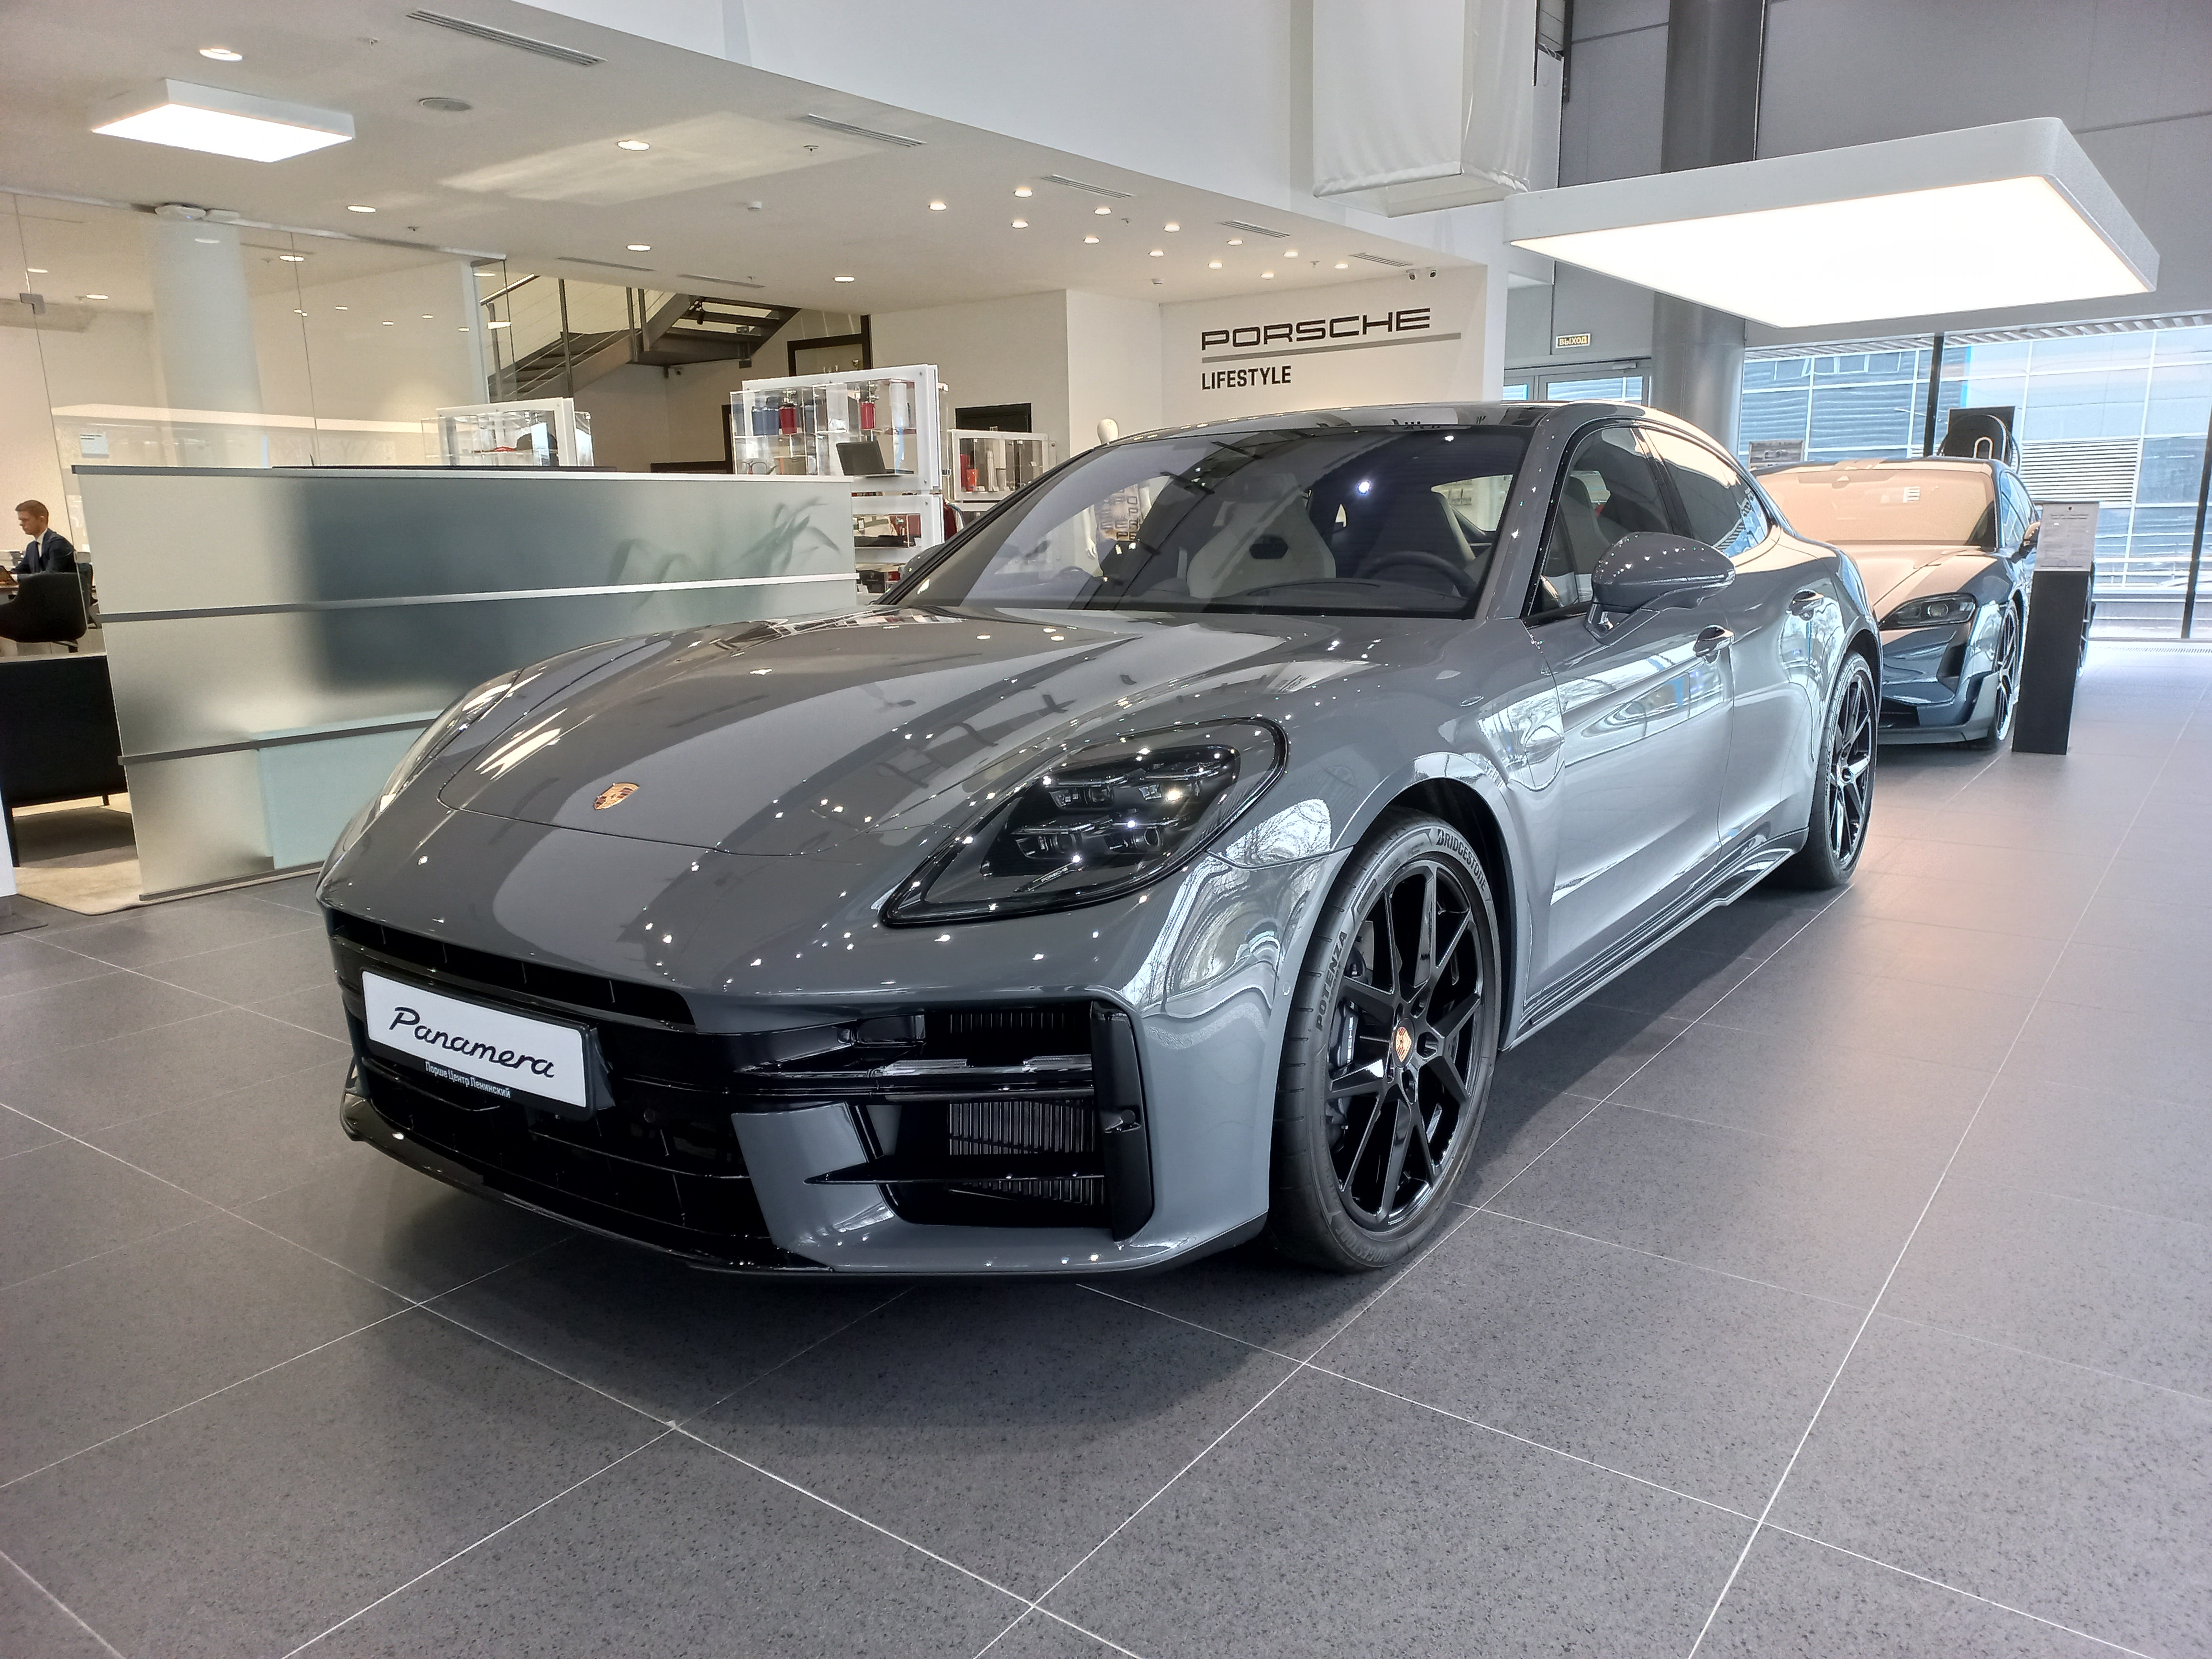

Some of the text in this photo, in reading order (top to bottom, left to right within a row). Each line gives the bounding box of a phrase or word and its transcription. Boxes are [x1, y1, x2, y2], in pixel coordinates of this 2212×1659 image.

[1202, 307, 1431, 351] PORSCHE
[1559, 336, 1587, 345] ВЫХОД
[1202, 365, 1292, 390] LIFESTYLE
[1436, 829, 1487, 891] BRIDGESTONE
[1316, 930, 1348, 1031] POTENZA
[388, 1006, 555, 1078] Panamera
[425, 1061, 511, 1098] Порше Центр Ленинский
